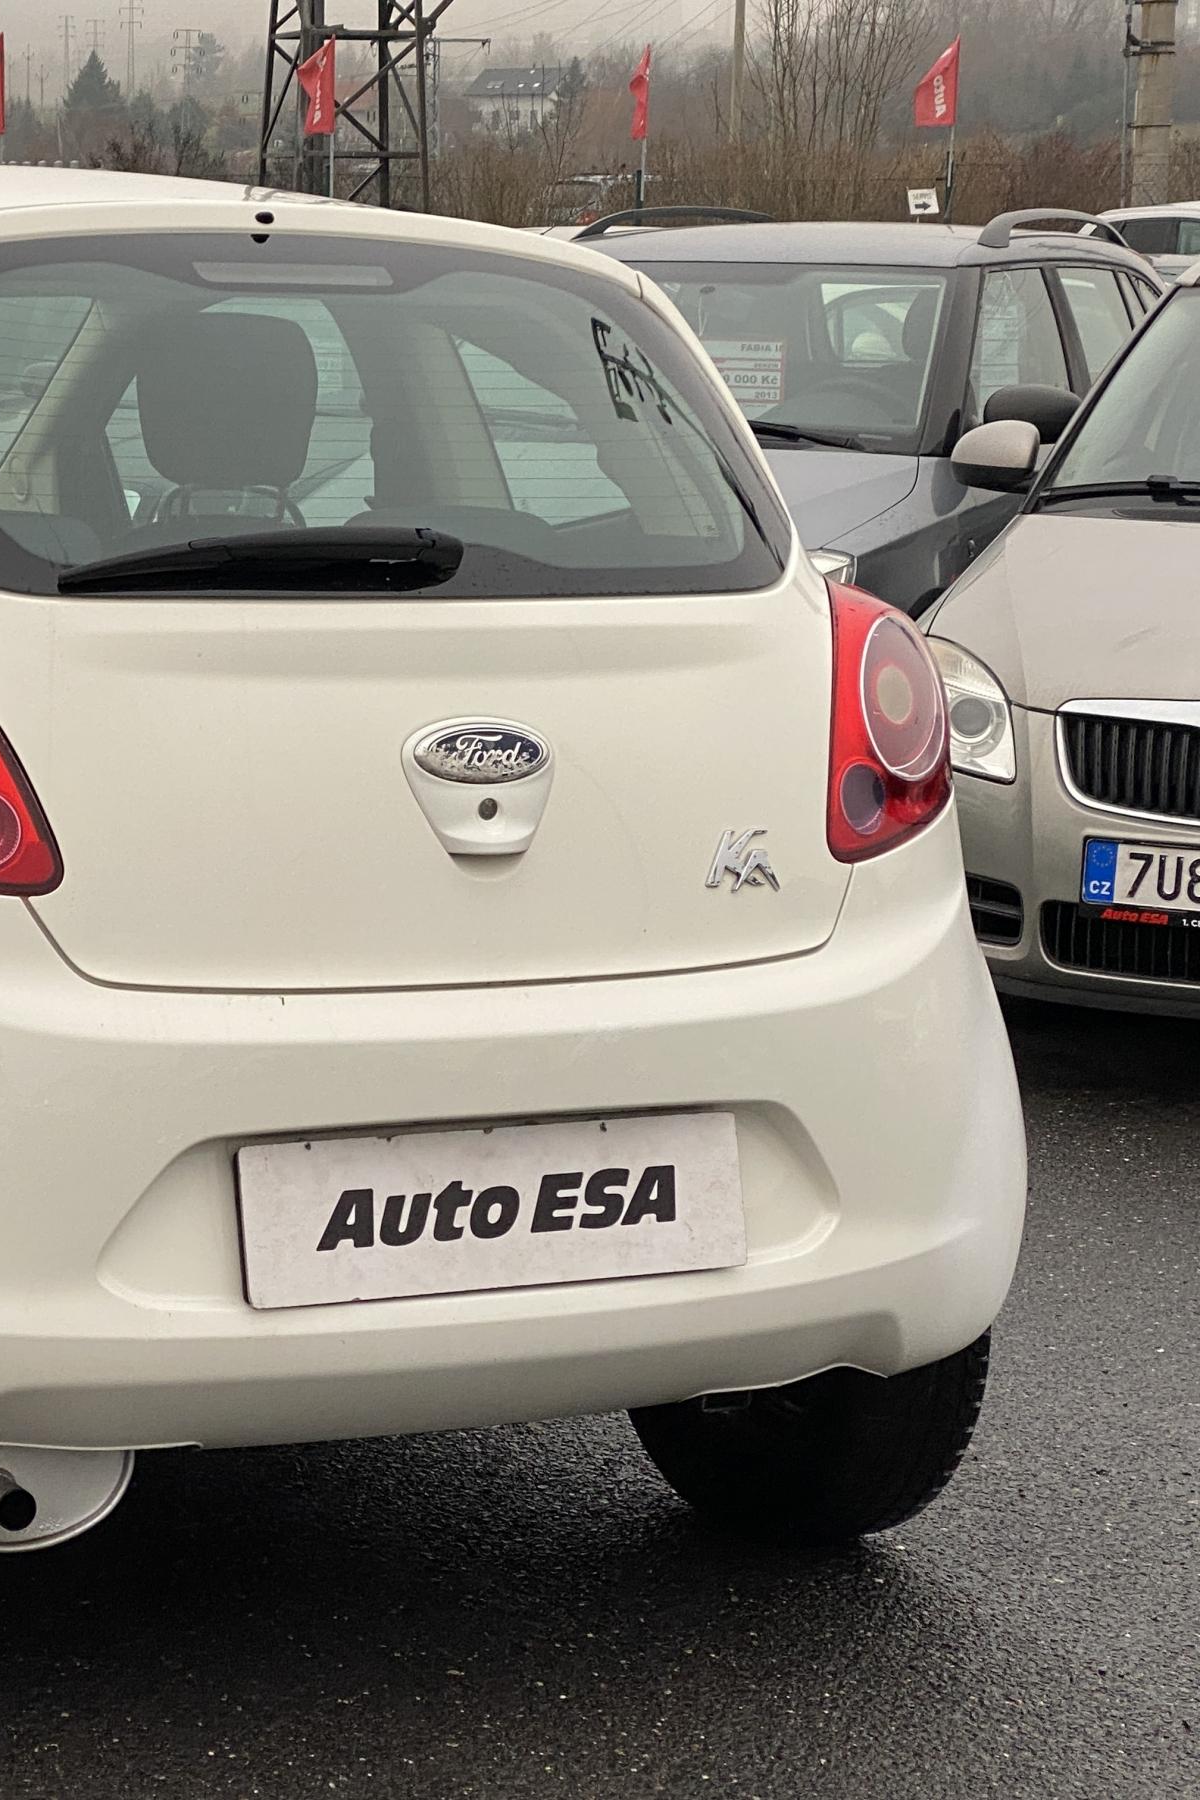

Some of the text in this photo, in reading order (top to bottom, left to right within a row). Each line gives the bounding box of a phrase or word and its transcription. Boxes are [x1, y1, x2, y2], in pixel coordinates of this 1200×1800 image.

[740, 343, 772, 352] FABIA
[734, 374, 757, 384] 000
[754, 391, 777, 399] 2013
[450, 734, 530, 767] Ford
[1089, 880, 1111, 895] CZ
[1101, 908, 1138, 922] Auto
[1139, 911, 1169, 925] ESA
[316, 1165, 676, 1252] Auto ESA
